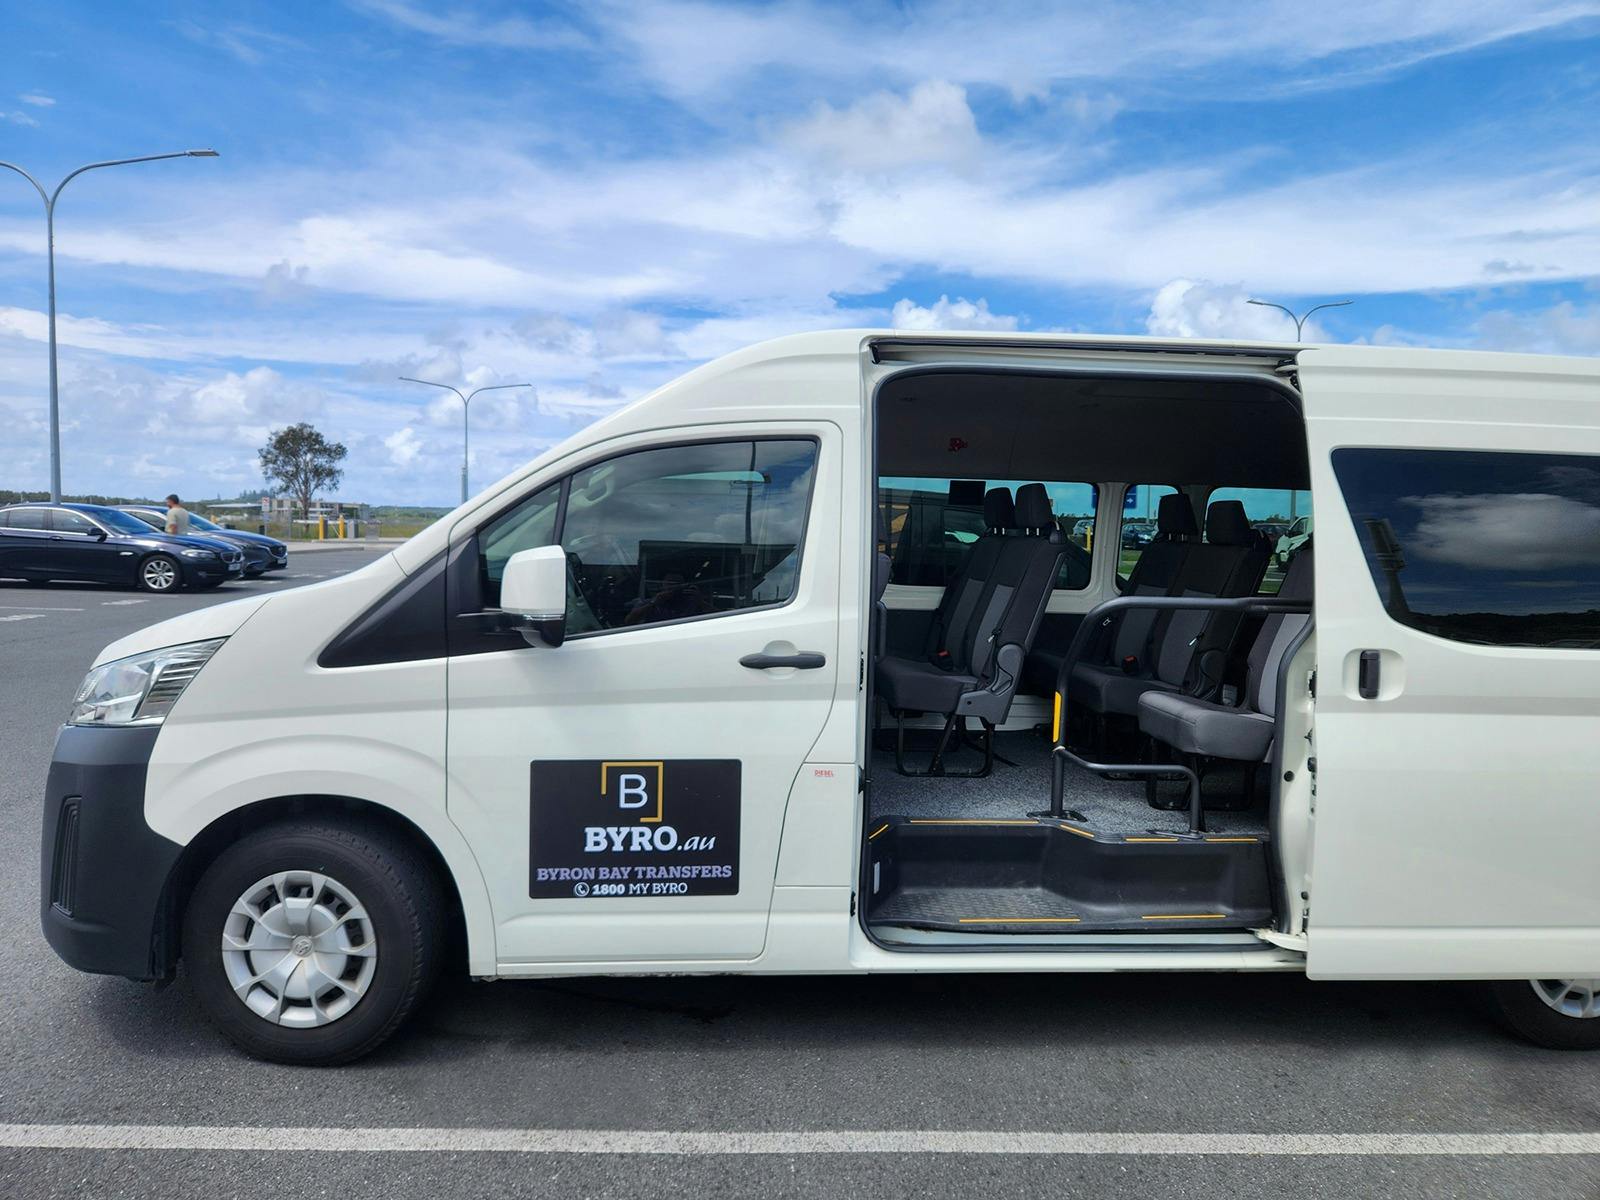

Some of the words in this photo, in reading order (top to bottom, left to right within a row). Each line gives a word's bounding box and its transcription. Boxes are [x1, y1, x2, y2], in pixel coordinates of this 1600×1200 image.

[619, 774, 648, 808] B
[536, 867, 595, 881] BYRON
[598, 866, 632, 880] BAY
[634, 865, 732, 879] TRANSFERS
[592, 883, 626, 895] 1800
[629, 883, 650, 895] MY
[652, 882, 688, 894] BYRO
